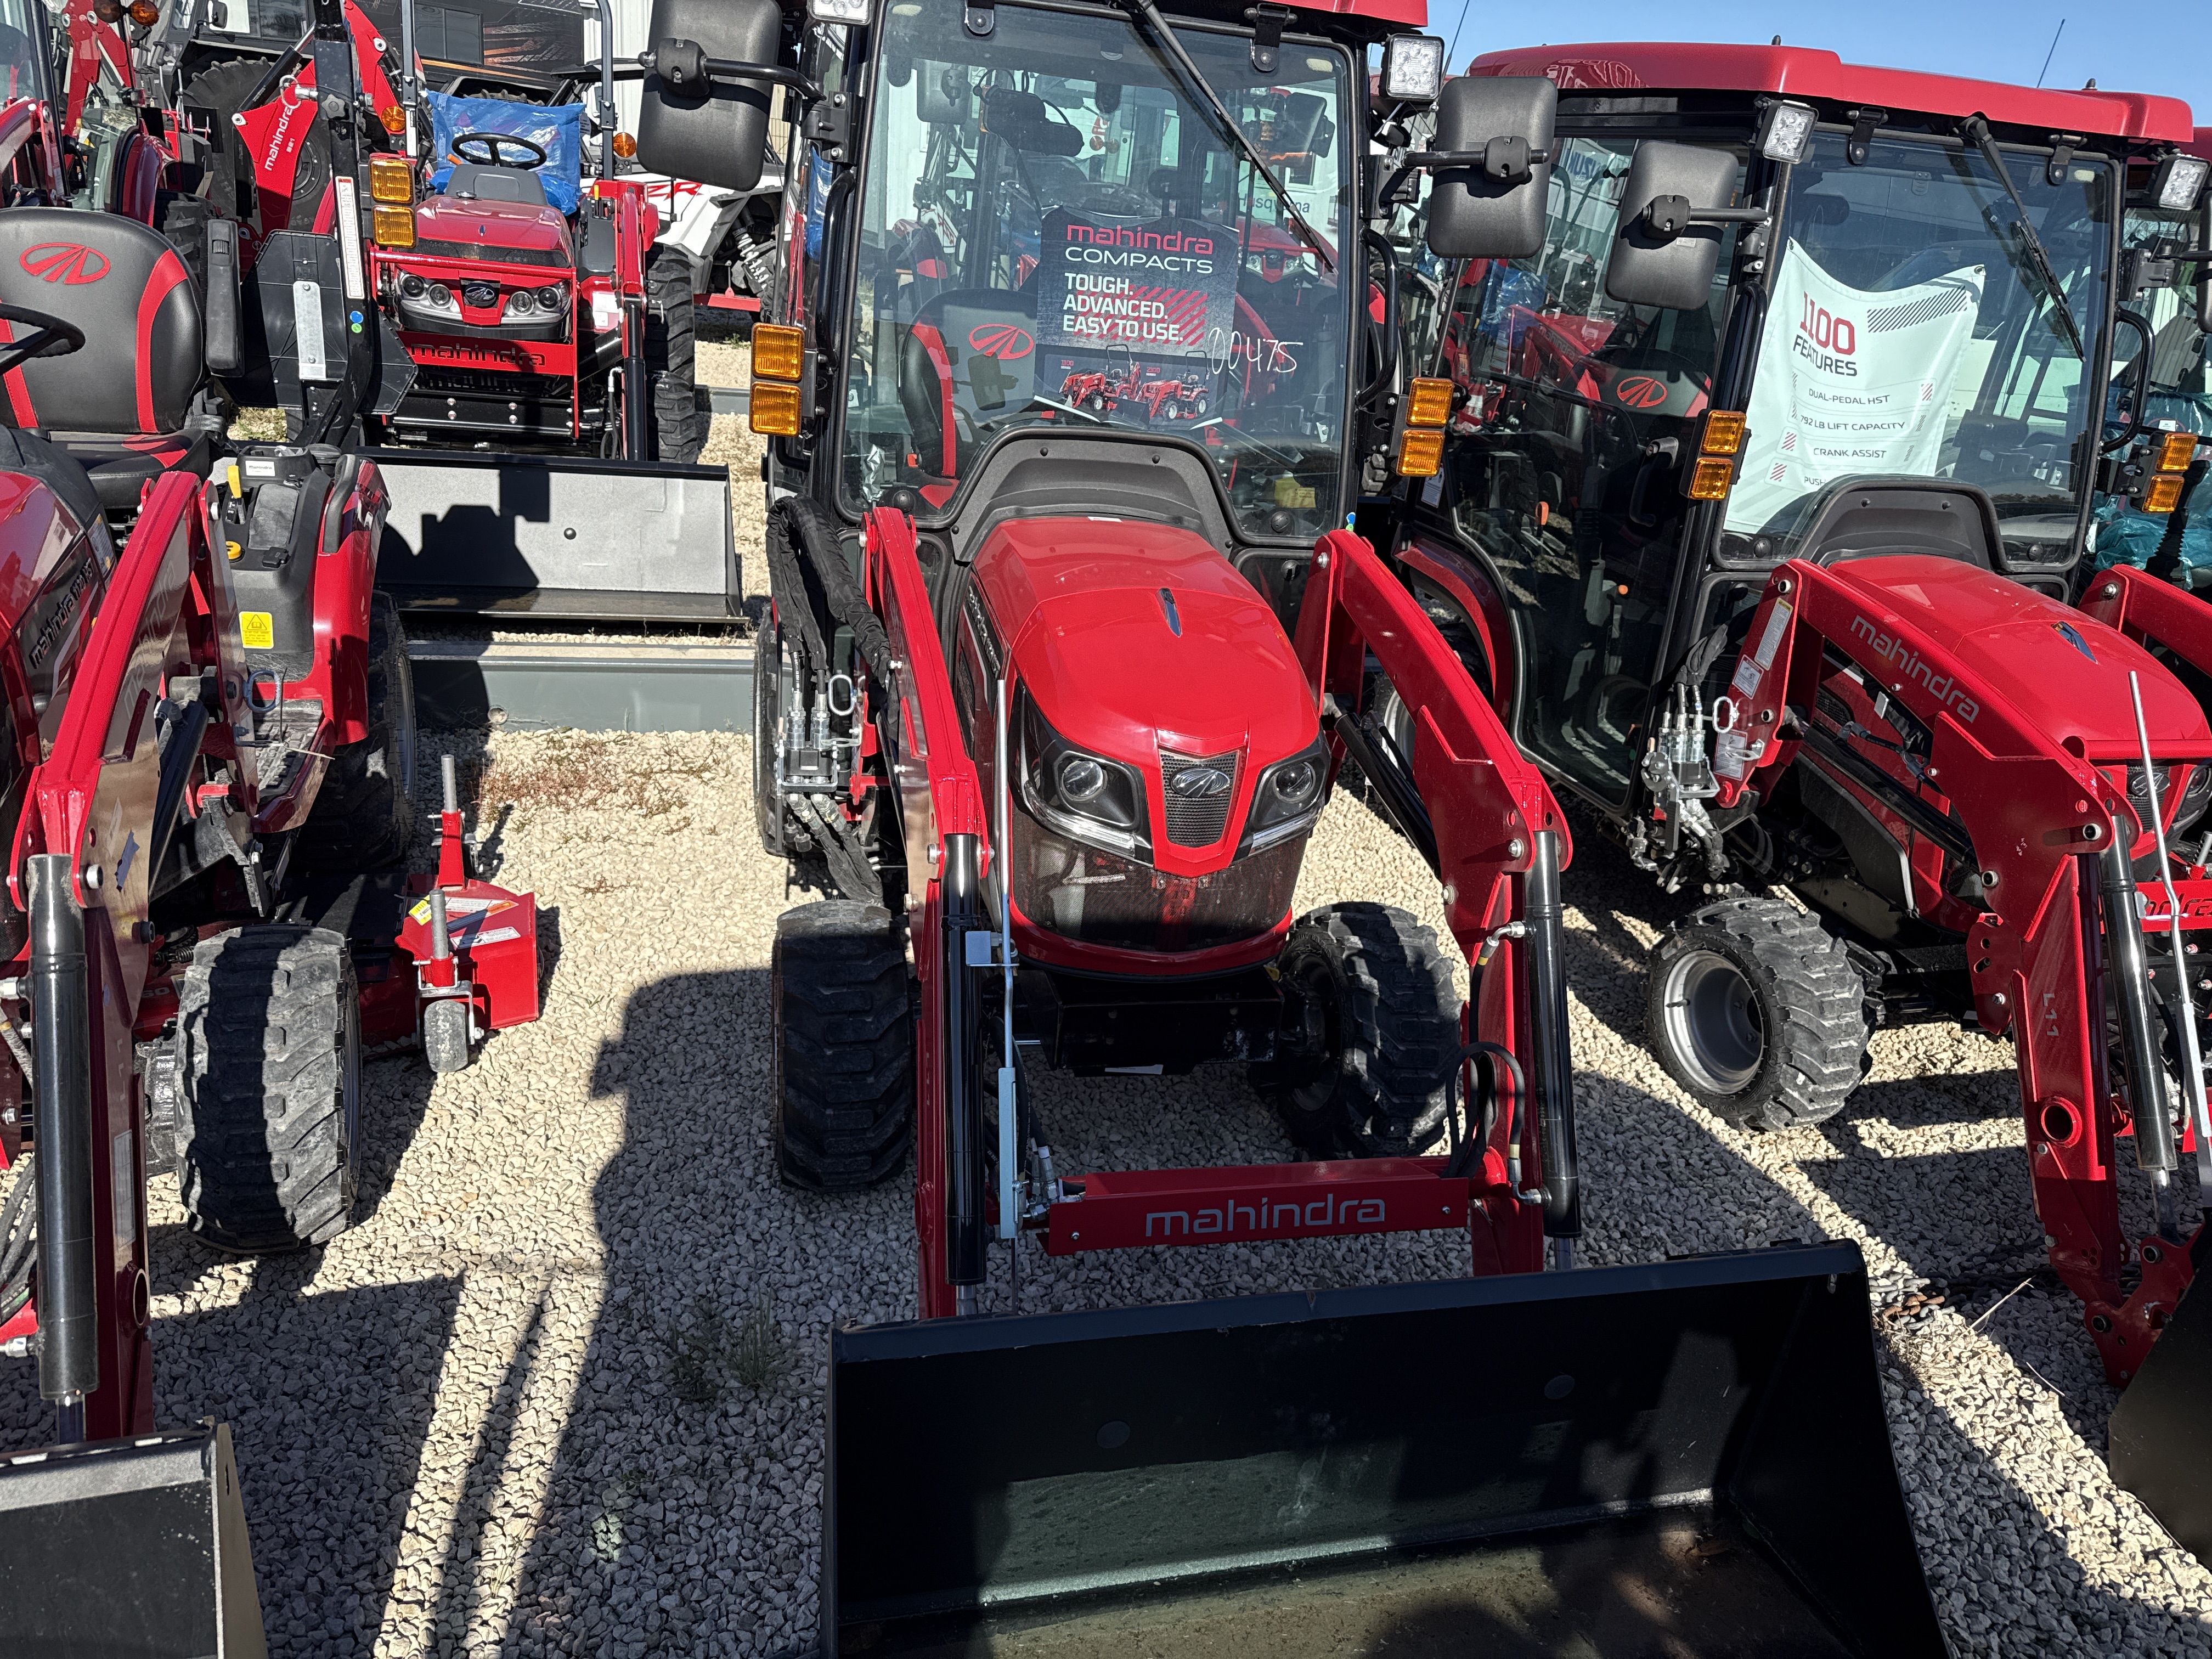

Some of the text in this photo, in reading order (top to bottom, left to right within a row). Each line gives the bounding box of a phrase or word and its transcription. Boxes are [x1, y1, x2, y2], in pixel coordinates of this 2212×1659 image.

[264, 106, 293, 171] mahindra
[1066, 225, 1214, 255] mahindra
[1065, 246, 1213, 274] COMPACTS
[1064, 273, 1133, 295] TOUGH.
[1063, 294, 1169, 319] ADVANCED.
[1063, 314, 1184, 341] EASY TO USE.
[1799, 291, 1856, 356] 1100
[411, 343, 546, 366] mahindra
[1207, 327, 1304, 375] 00475
[1792, 334, 1858, 377] FEATURES
[1809, 388, 1891, 405] DUAL-PEDAL HST
[1800, 415, 1905, 431] 792 LB LIFT CAPACITY
[1813, 448, 1887, 459] CRANK ASSIST
[29, 594, 76, 669] mahindra
[1850, 614, 1980, 724] mahindra
[2042, 992, 2059, 1036] L11
[1145, 1193, 1386, 1237] mahindra
